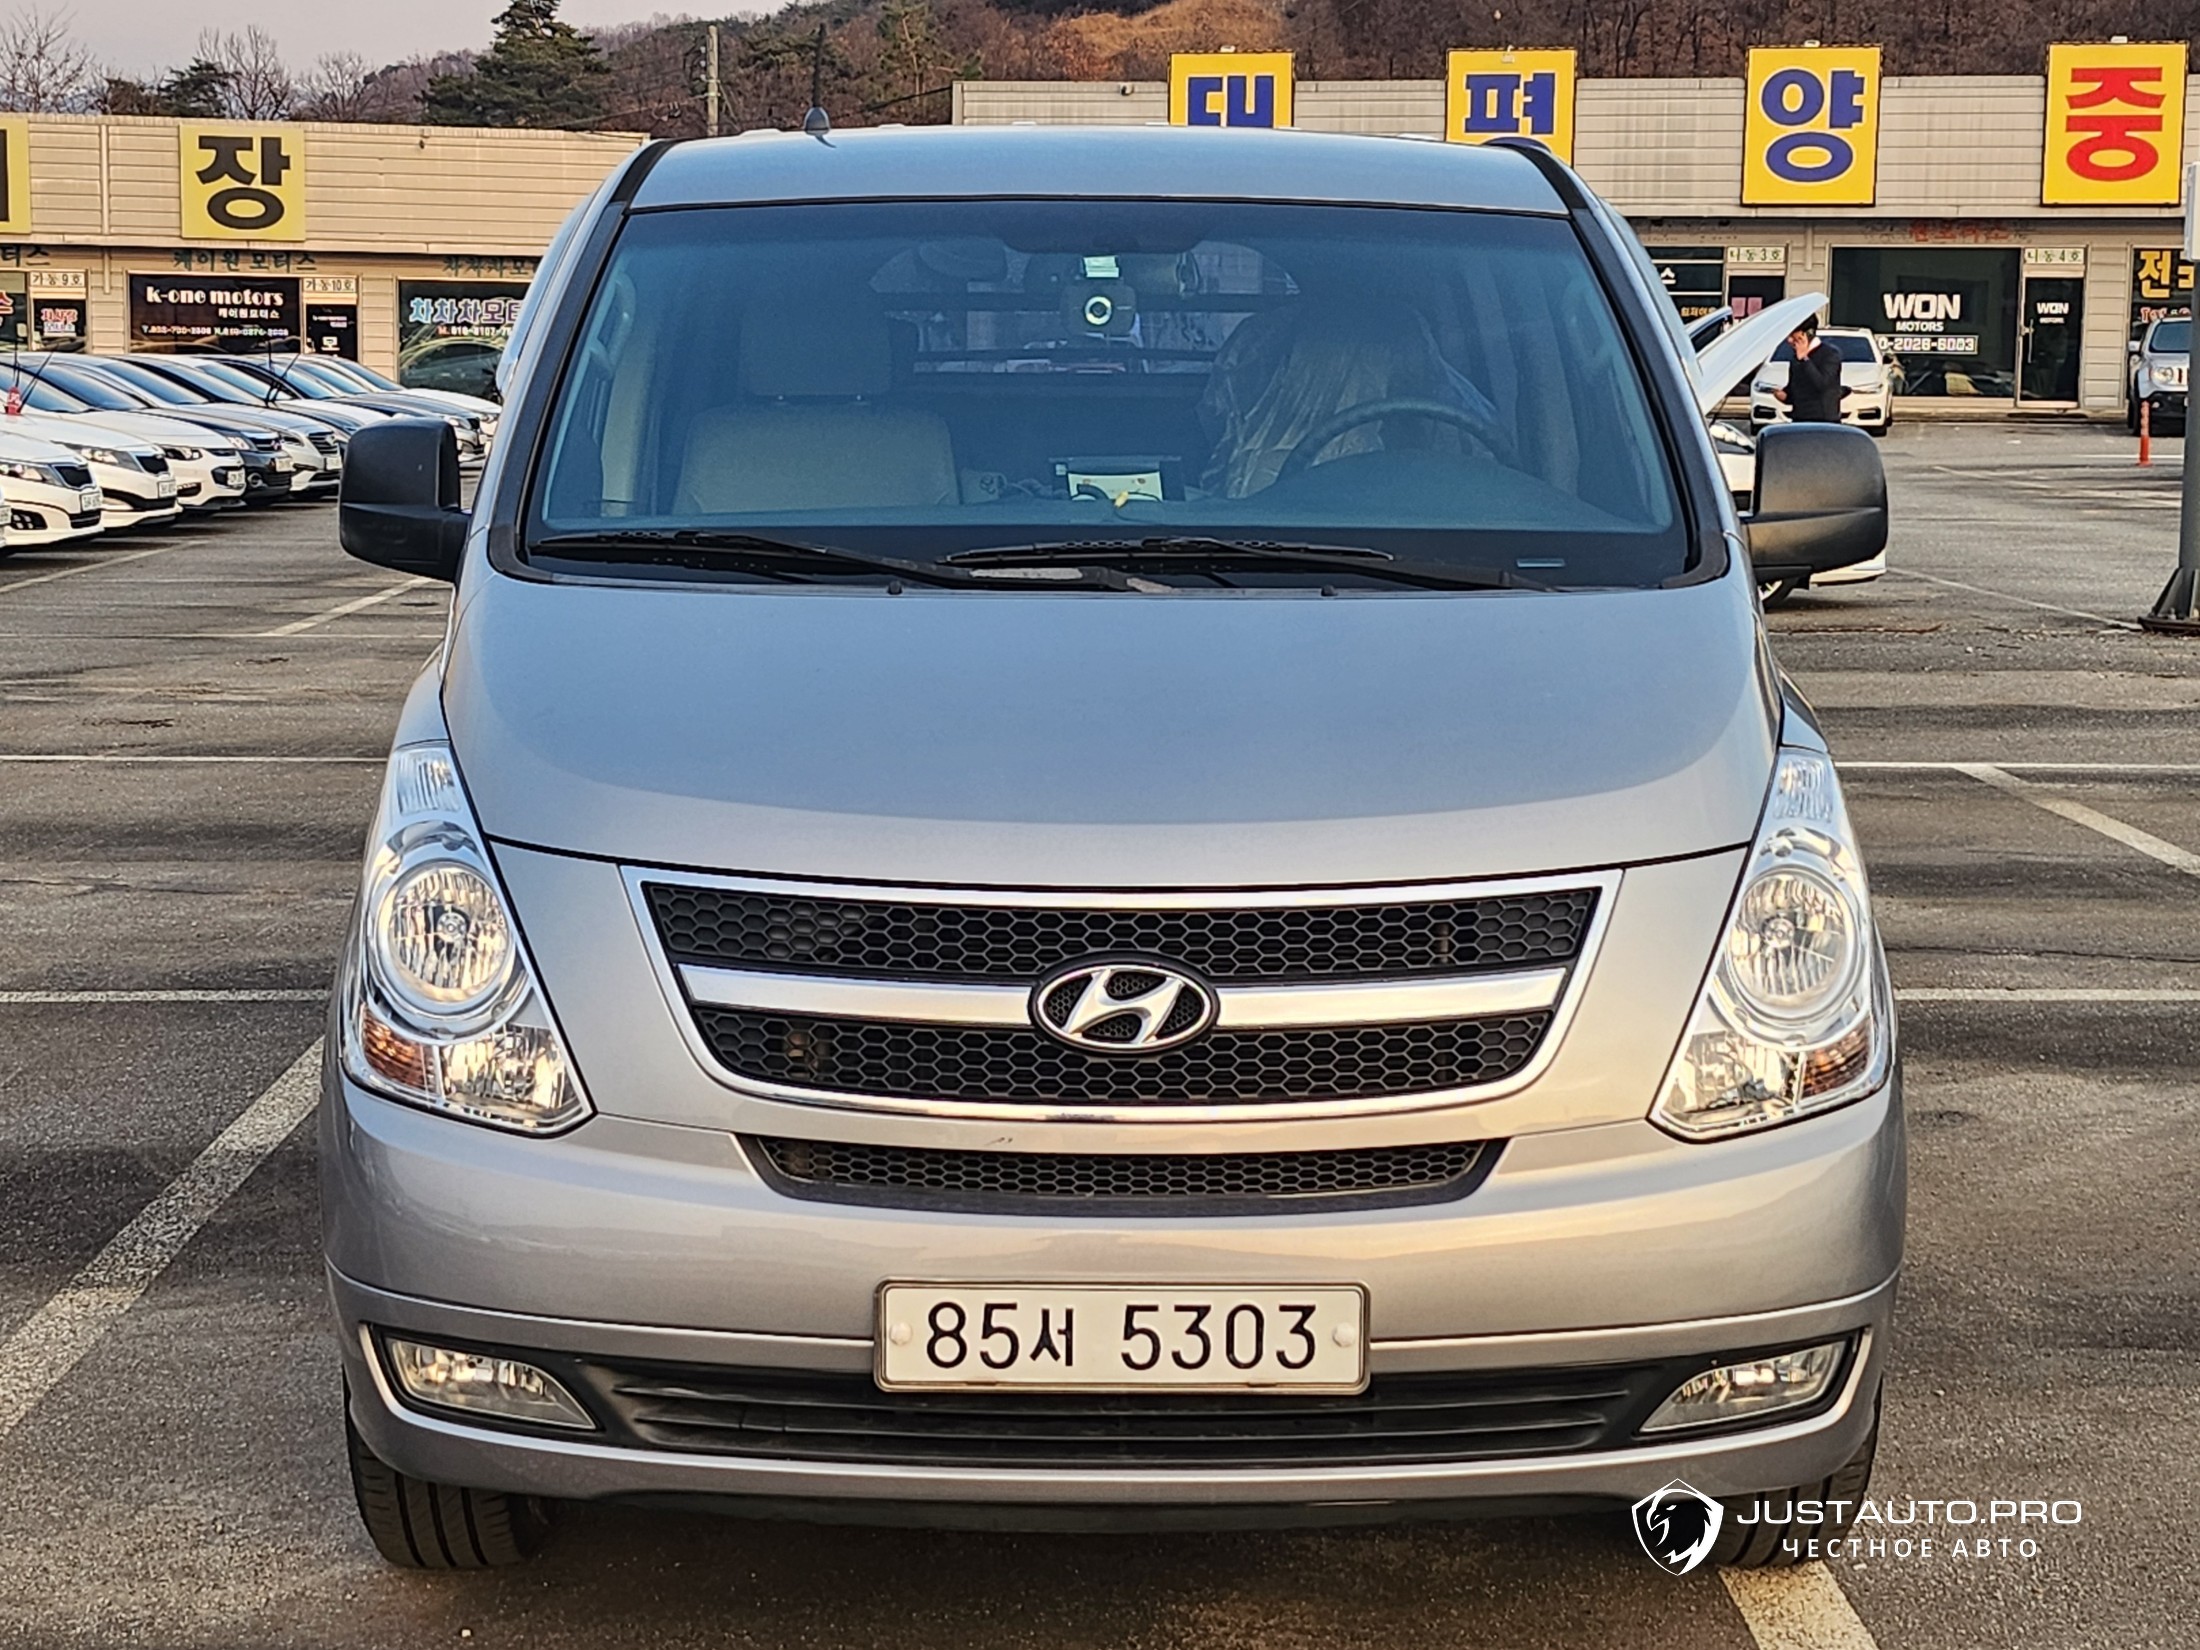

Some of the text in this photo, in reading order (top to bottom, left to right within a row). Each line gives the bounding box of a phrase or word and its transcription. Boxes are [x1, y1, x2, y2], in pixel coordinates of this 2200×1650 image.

[1761, 68, 1865, 183] 양
[2064, 66, 2166, 182] 중
[195, 136, 291, 230] 장
[146, 285, 284, 307] k-one motors
[1883, 294, 1961, 320] WON
[2036, 302, 2069, 315] WON
[1896, 321, 1944, 332] MOTORS
[926, 1301, 1317, 1371] 85서 5303
